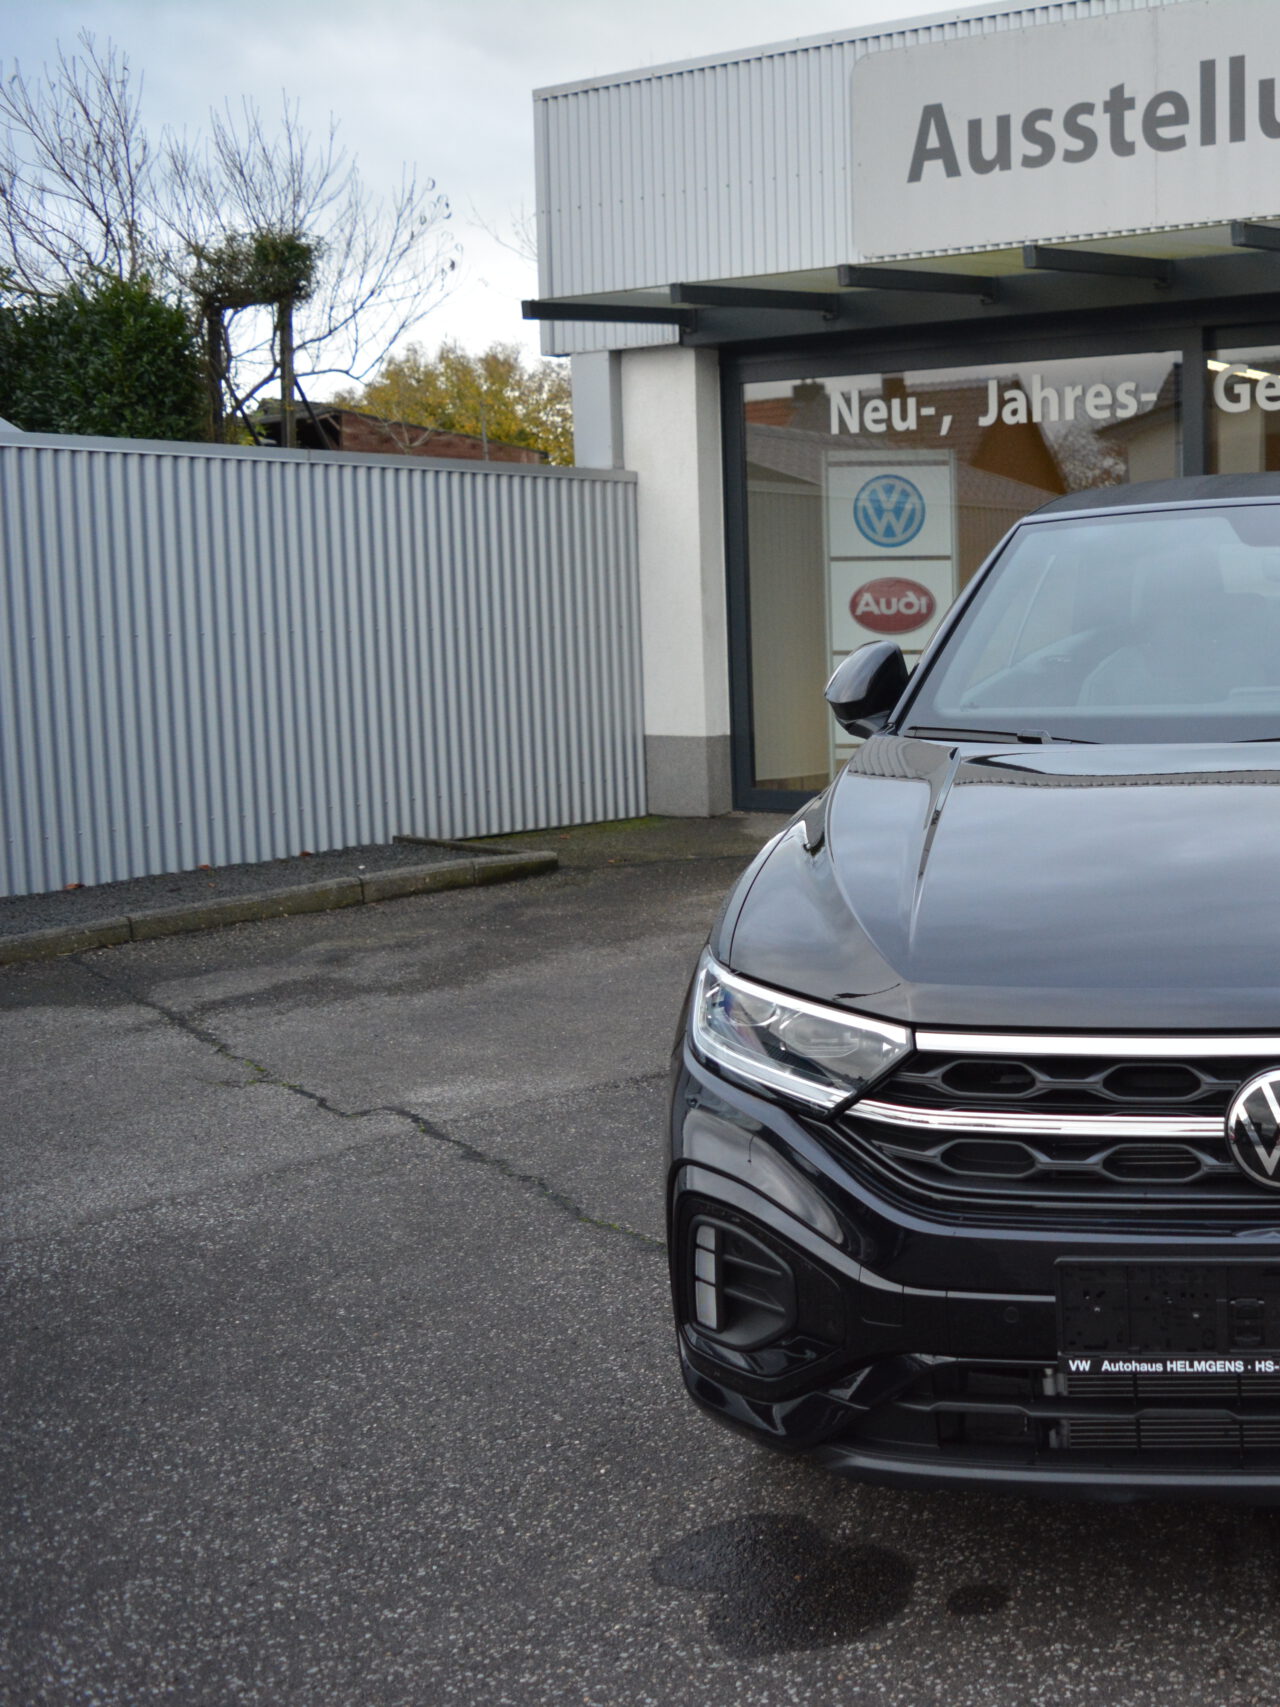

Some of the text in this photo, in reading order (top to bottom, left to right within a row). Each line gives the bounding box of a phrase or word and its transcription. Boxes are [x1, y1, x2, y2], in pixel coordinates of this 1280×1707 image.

[829, 388, 954, 437] Neu-,
[977, 373, 1158, 428] Jahres-
[855, 591, 929, 616] Audi
[1068, 1359, 1092, 1372] VW
[1101, 1359, 1164, 1373] Autohaus
[1166, 1359, 1245, 1373] HELMGENS
